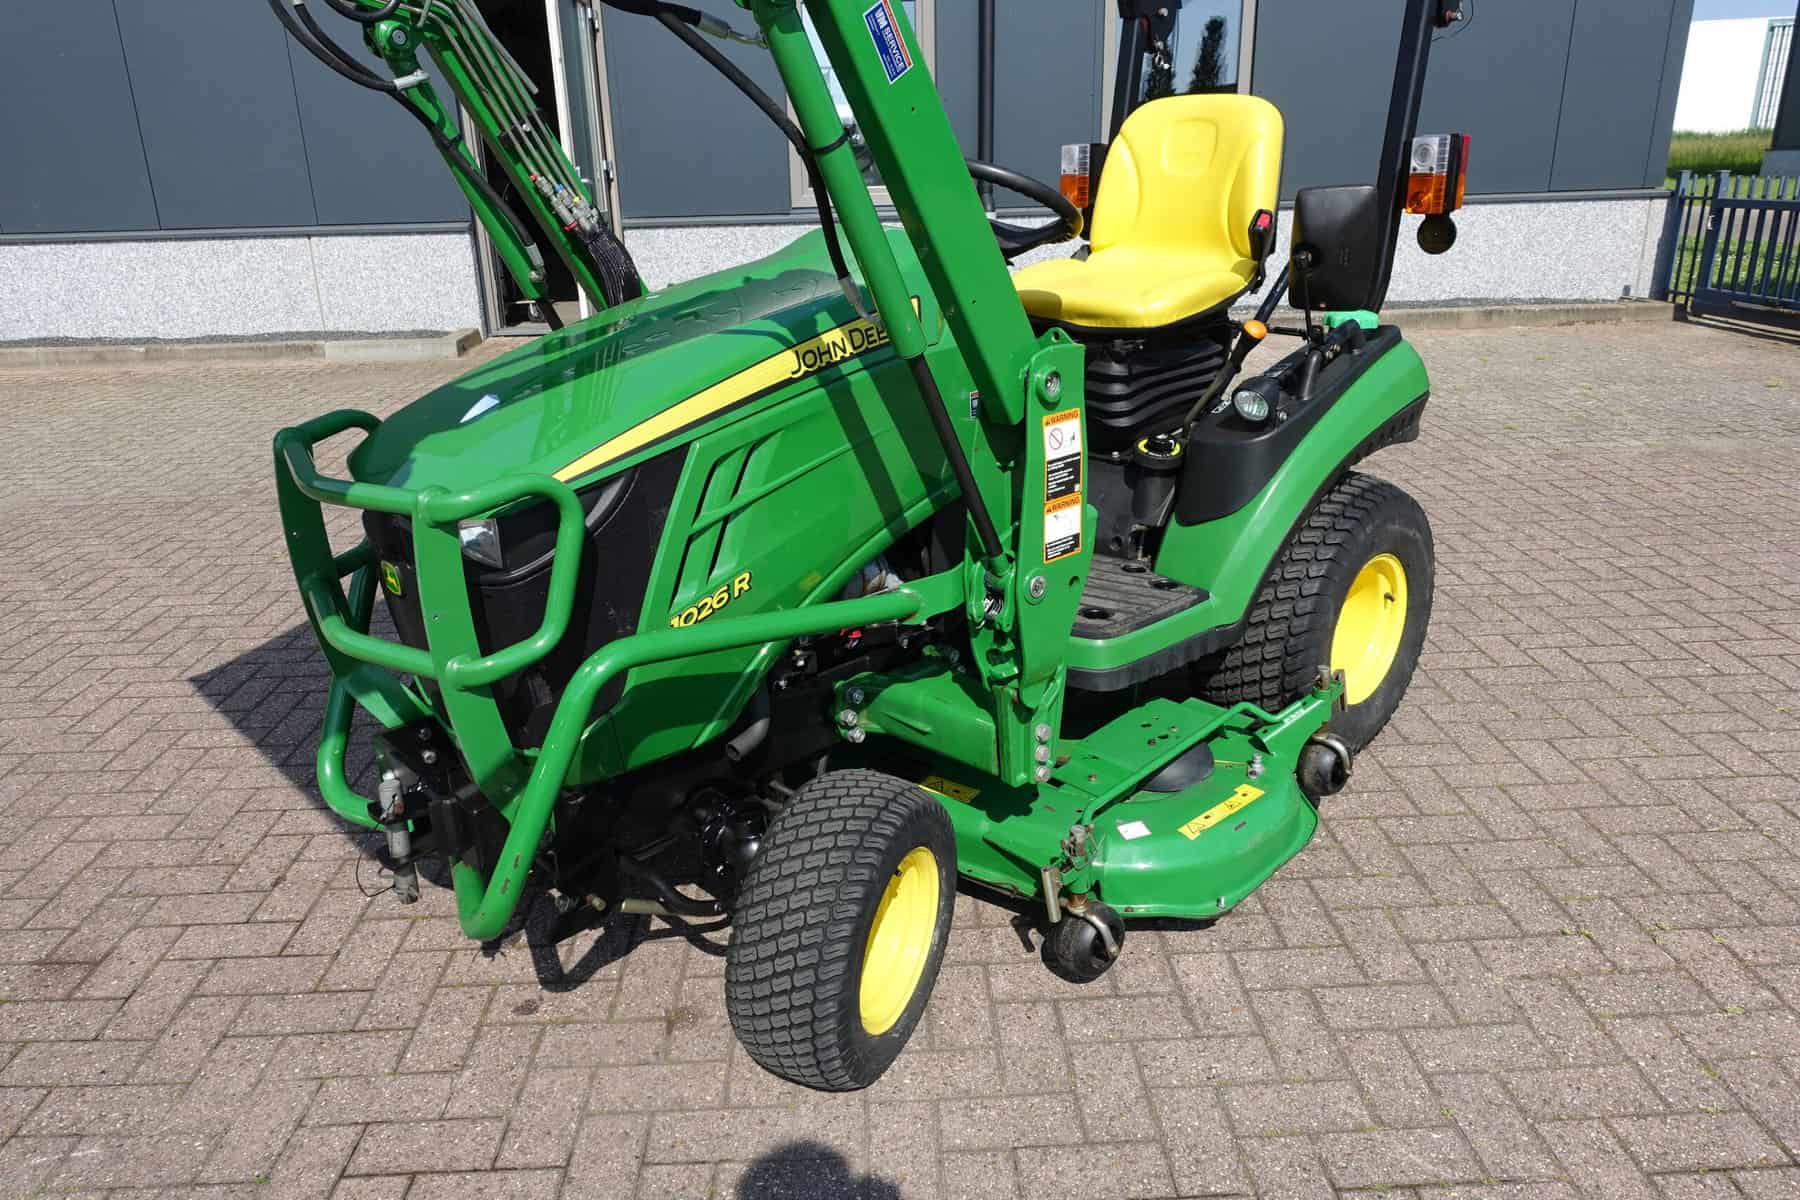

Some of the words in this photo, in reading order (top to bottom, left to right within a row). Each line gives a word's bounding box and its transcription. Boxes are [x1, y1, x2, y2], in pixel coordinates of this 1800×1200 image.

[883, 26, 905, 73] SERVICE
[791, 337, 848, 375] JOHN
[1050, 409, 1079, 424] WARNING
[1051, 495, 1080, 512] WARNING
[669, 584, 730, 628] 1026
[732, 571, 752, 599] R
